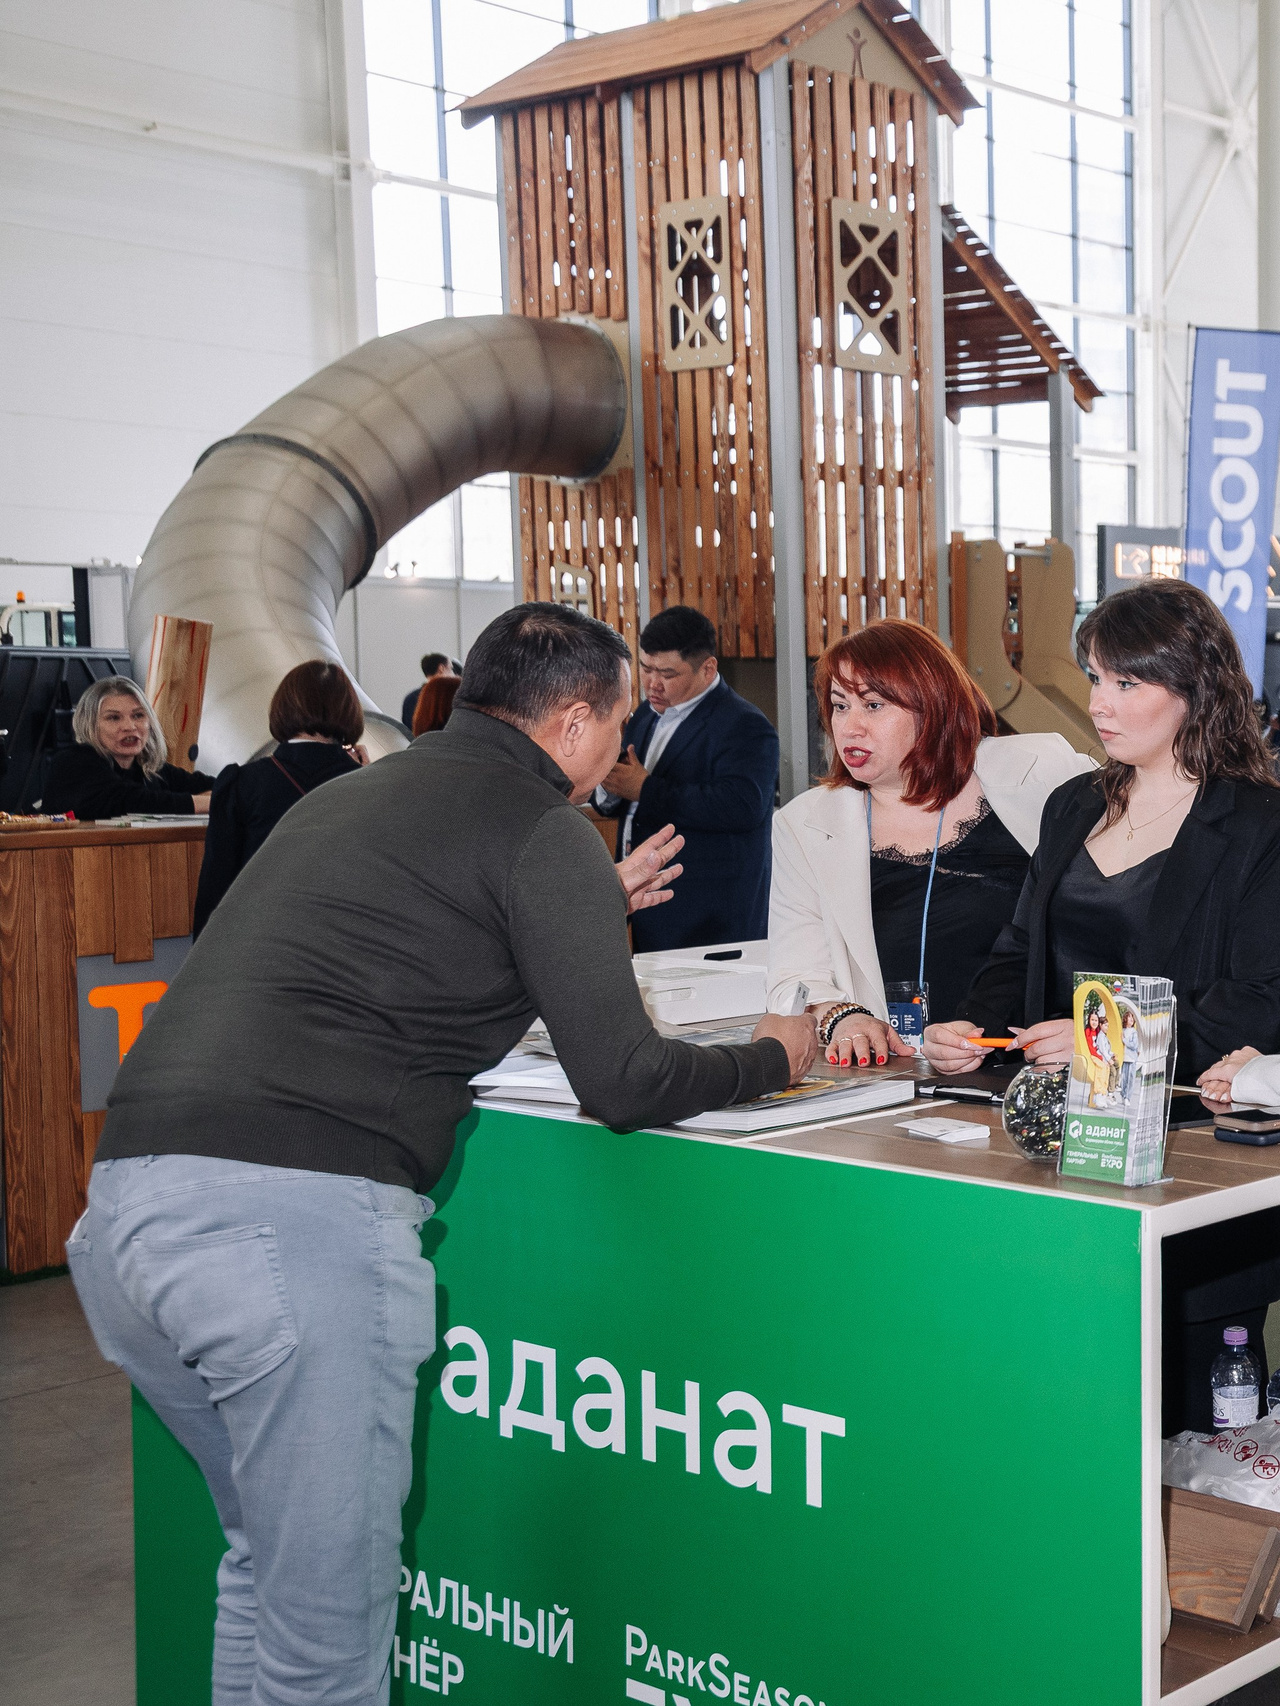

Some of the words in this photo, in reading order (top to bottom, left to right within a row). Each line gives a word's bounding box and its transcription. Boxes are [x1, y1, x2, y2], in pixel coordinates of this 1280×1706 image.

[1207, 358, 1267, 613] SCOUT
[1085, 1124, 1126, 1140] аданат
[1101, 1158, 1123, 1170] EXPO
[440, 1325, 846, 1508] аданат
